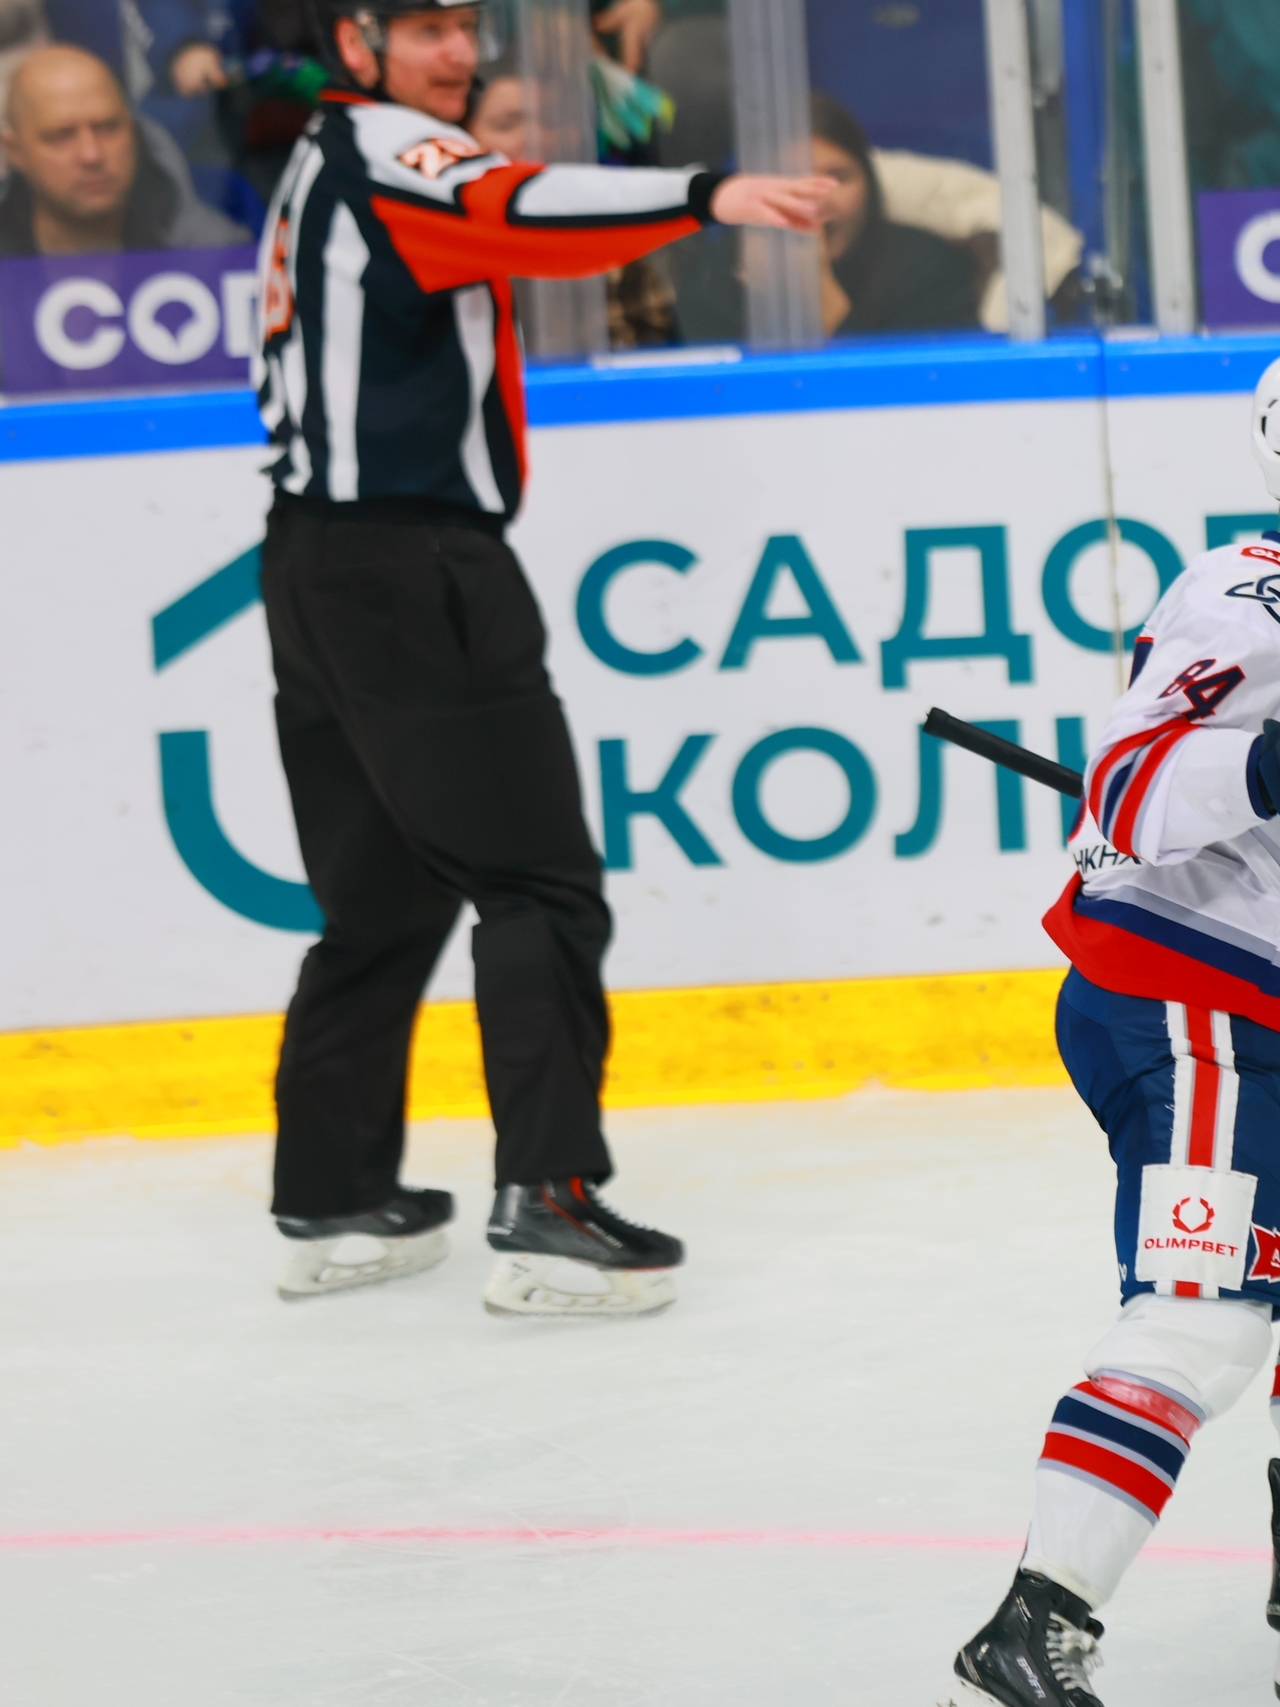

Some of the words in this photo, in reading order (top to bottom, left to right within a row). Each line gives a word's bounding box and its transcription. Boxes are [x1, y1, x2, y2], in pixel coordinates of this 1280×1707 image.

[34, 270, 257, 370] сог
[1156, 658, 1246, 721] 84
[1144, 1237, 1239, 1257] OLIMPBET
